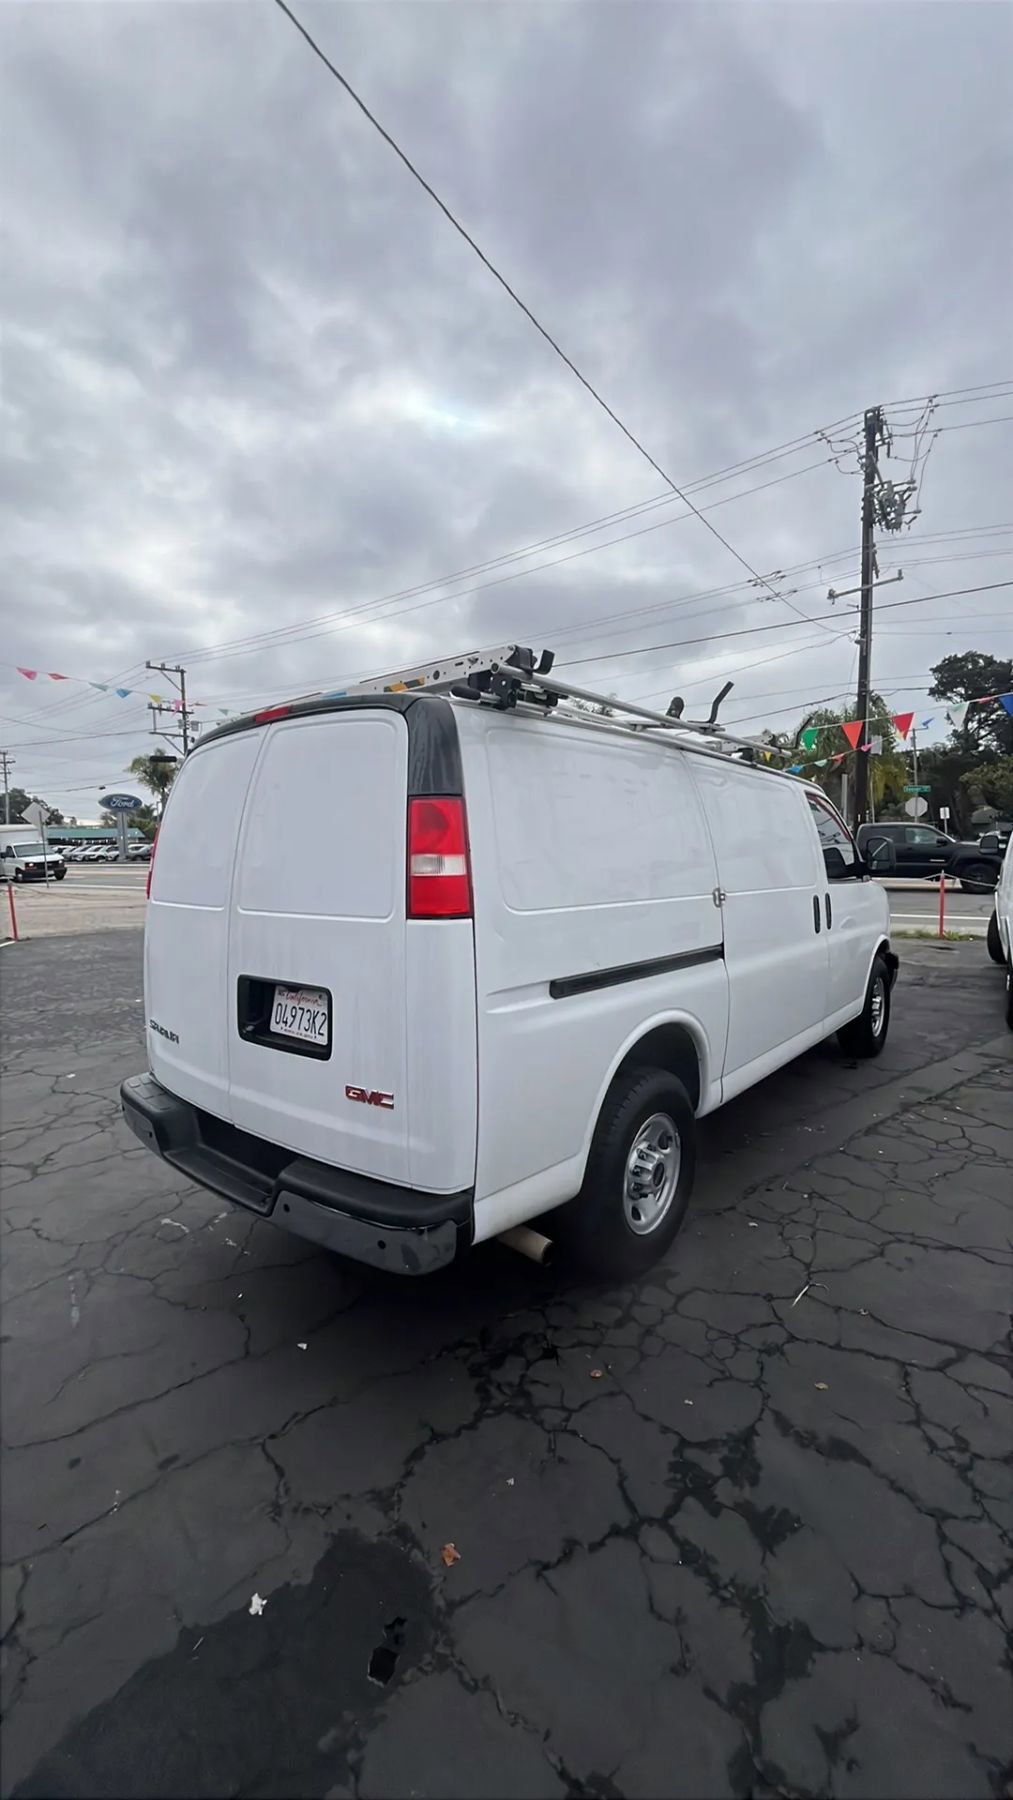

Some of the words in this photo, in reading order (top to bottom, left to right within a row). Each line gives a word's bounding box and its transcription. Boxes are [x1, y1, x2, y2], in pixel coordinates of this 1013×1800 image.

[110, 796, 134, 808] Ford
[275, 1003, 327, 1037] 04973K2
[344, 1084, 394, 1110] GMC
